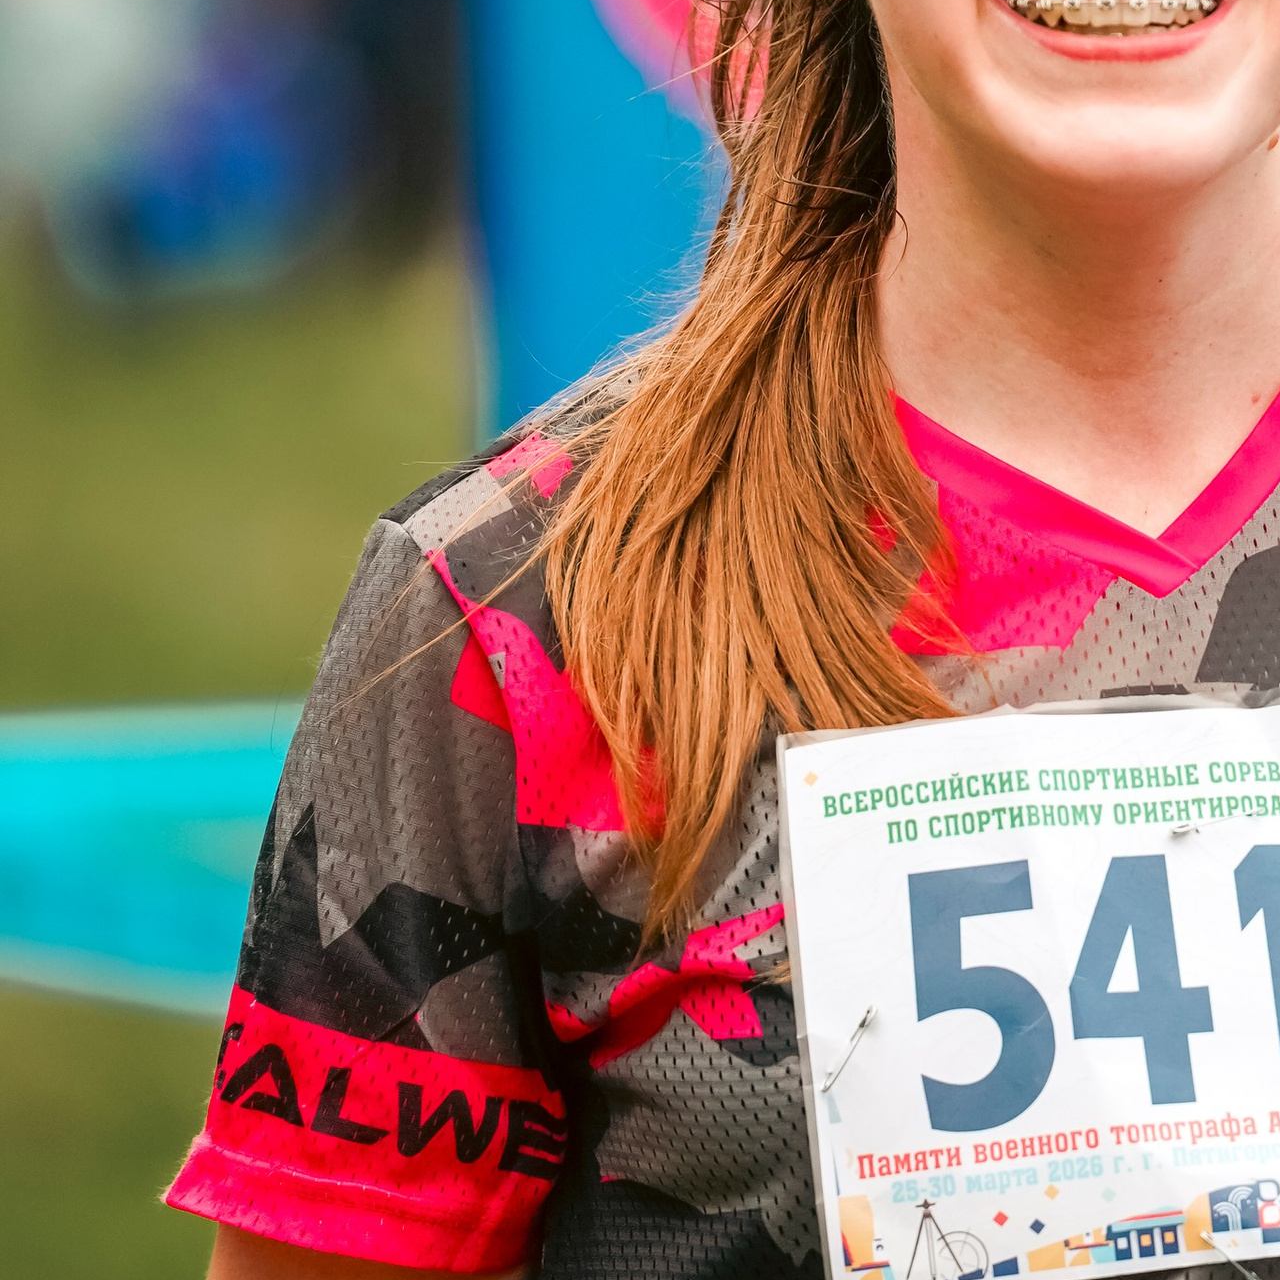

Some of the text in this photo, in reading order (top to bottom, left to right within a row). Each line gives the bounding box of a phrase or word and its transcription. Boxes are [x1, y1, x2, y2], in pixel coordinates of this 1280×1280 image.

[823, 769, 1030, 818] ВСЕРОССИЙСКИЕ
[1038, 764, 1200, 792] СПОРТИВНЫЕ
[887, 818, 919, 844] ПО
[928, 803, 1103, 839] СПОРТИВНОМУ
[857, 1145, 962, 1180] Памяти
[973, 1127, 1099, 1164] военного
[1110, 1111, 1257, 1148] топографа
[891, 1174, 957, 1203] 25-30
[966, 1164, 1039, 1195] марта
[1048, 1155, 1104, 1183] 2026
[1113, 1155, 1133, 1173] г.
